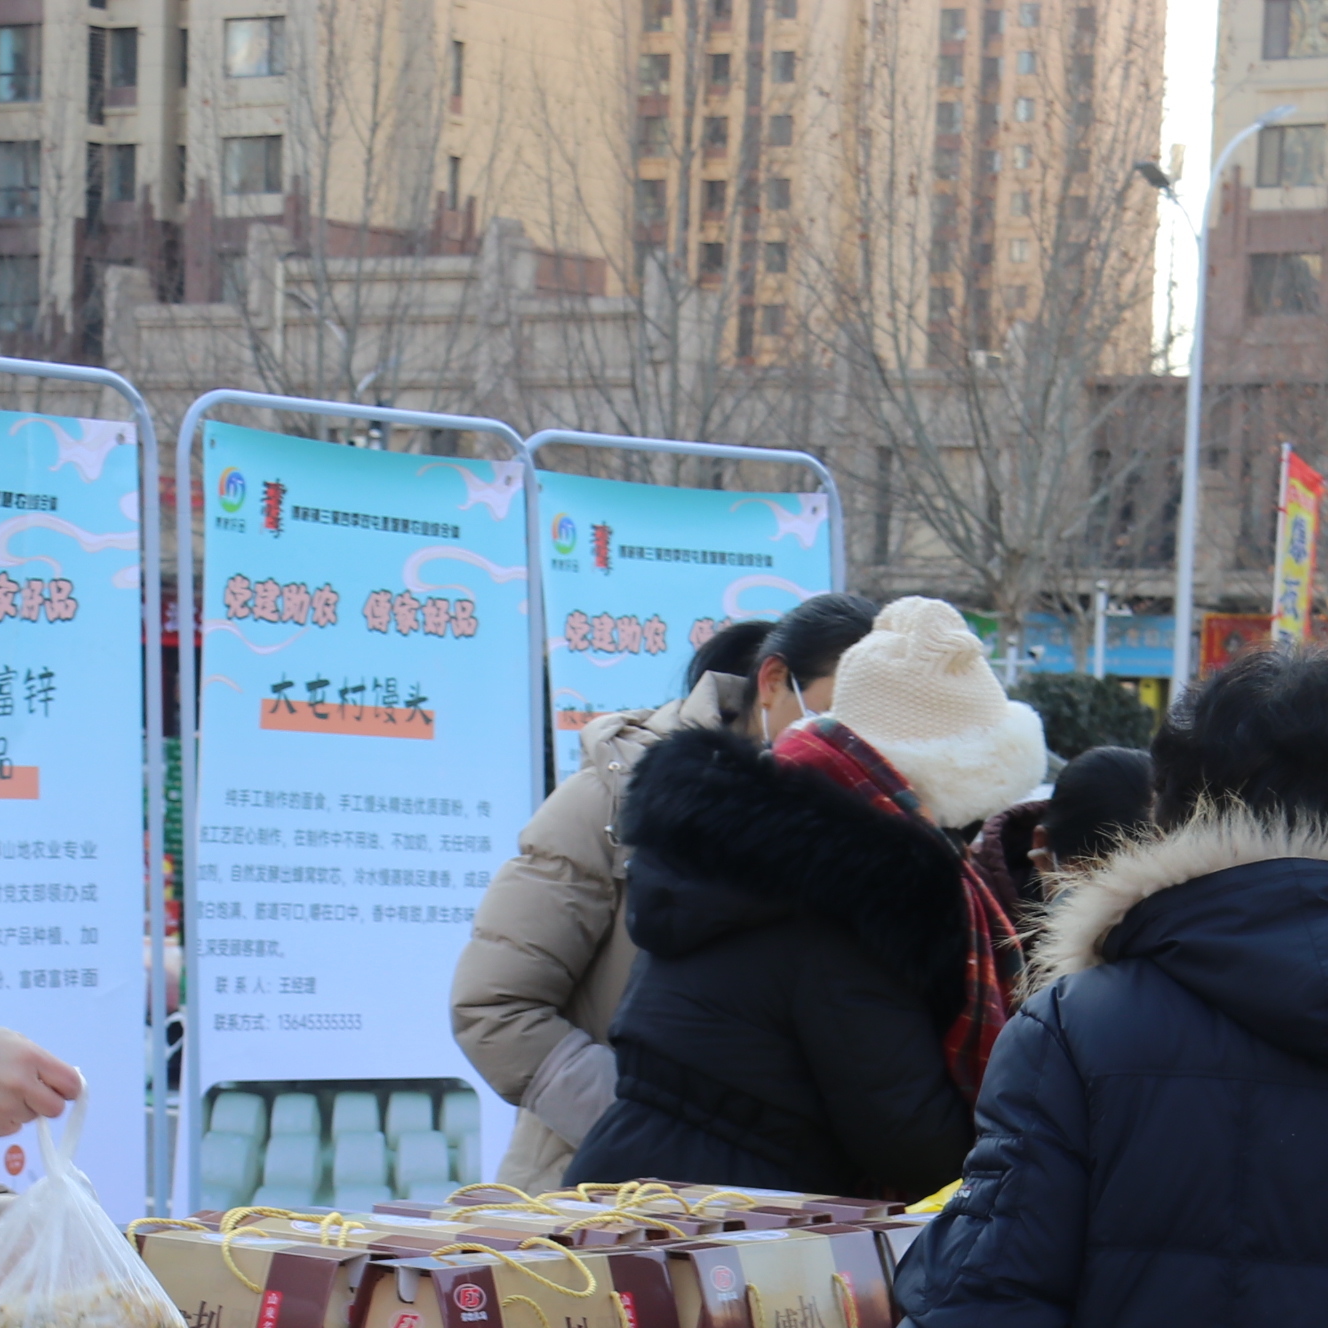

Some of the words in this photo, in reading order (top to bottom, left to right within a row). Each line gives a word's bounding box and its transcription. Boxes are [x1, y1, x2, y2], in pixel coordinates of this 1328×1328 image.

[224, 573, 339, 628] 党建助农
[364, 589, 478, 639] 傅家好品
[269, 671, 433, 724] 大屯村馒头
